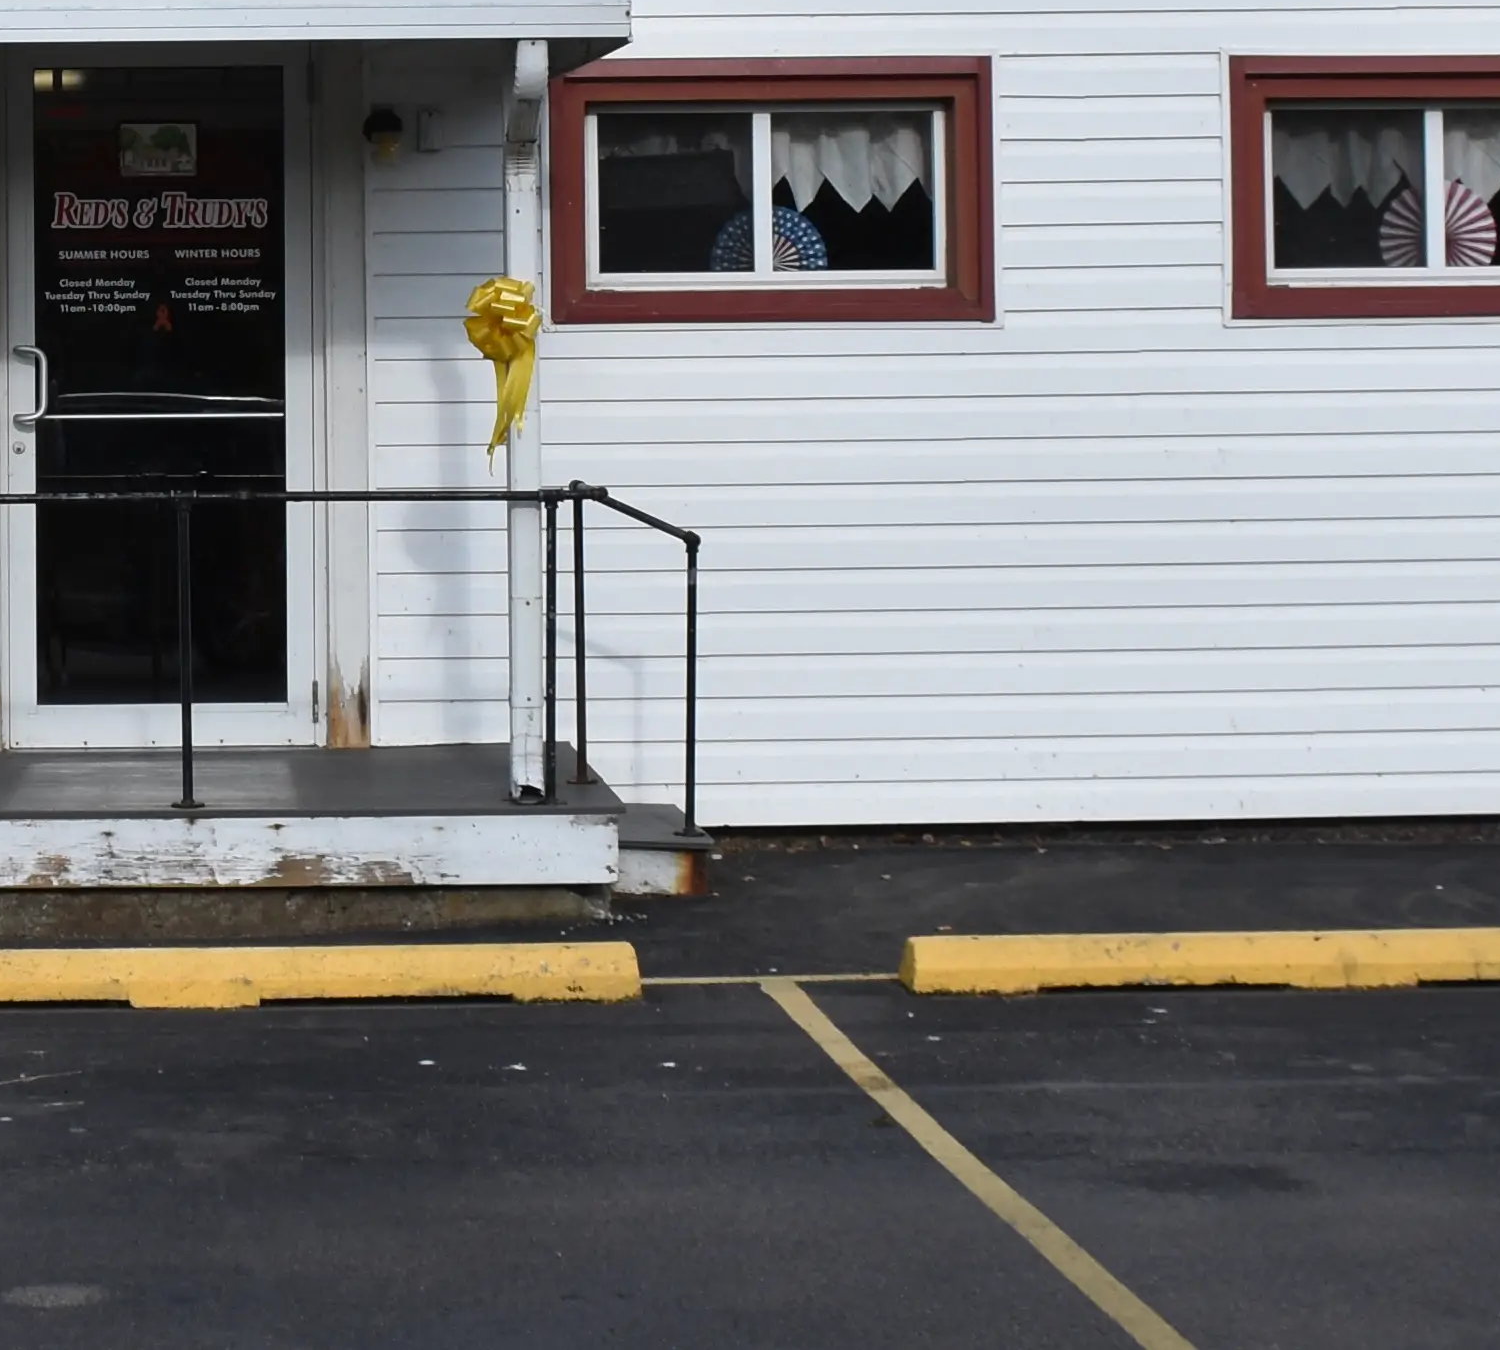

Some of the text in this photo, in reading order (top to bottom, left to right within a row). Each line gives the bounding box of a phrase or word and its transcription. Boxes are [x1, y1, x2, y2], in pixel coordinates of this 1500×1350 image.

[51, 191, 268, 229] RED'S & TRUDY'S
[58, 249, 150, 260] SUMMER HOURS
[175, 248, 261, 259] WINTER HOURS
[59, 278, 136, 289] Closed Monday
[184, 277, 261, 288] Closed Monday
[45, 290, 151, 302] Tuesday Thru Sunday
[170, 290, 277, 301] Tuesday Thru Sunday
